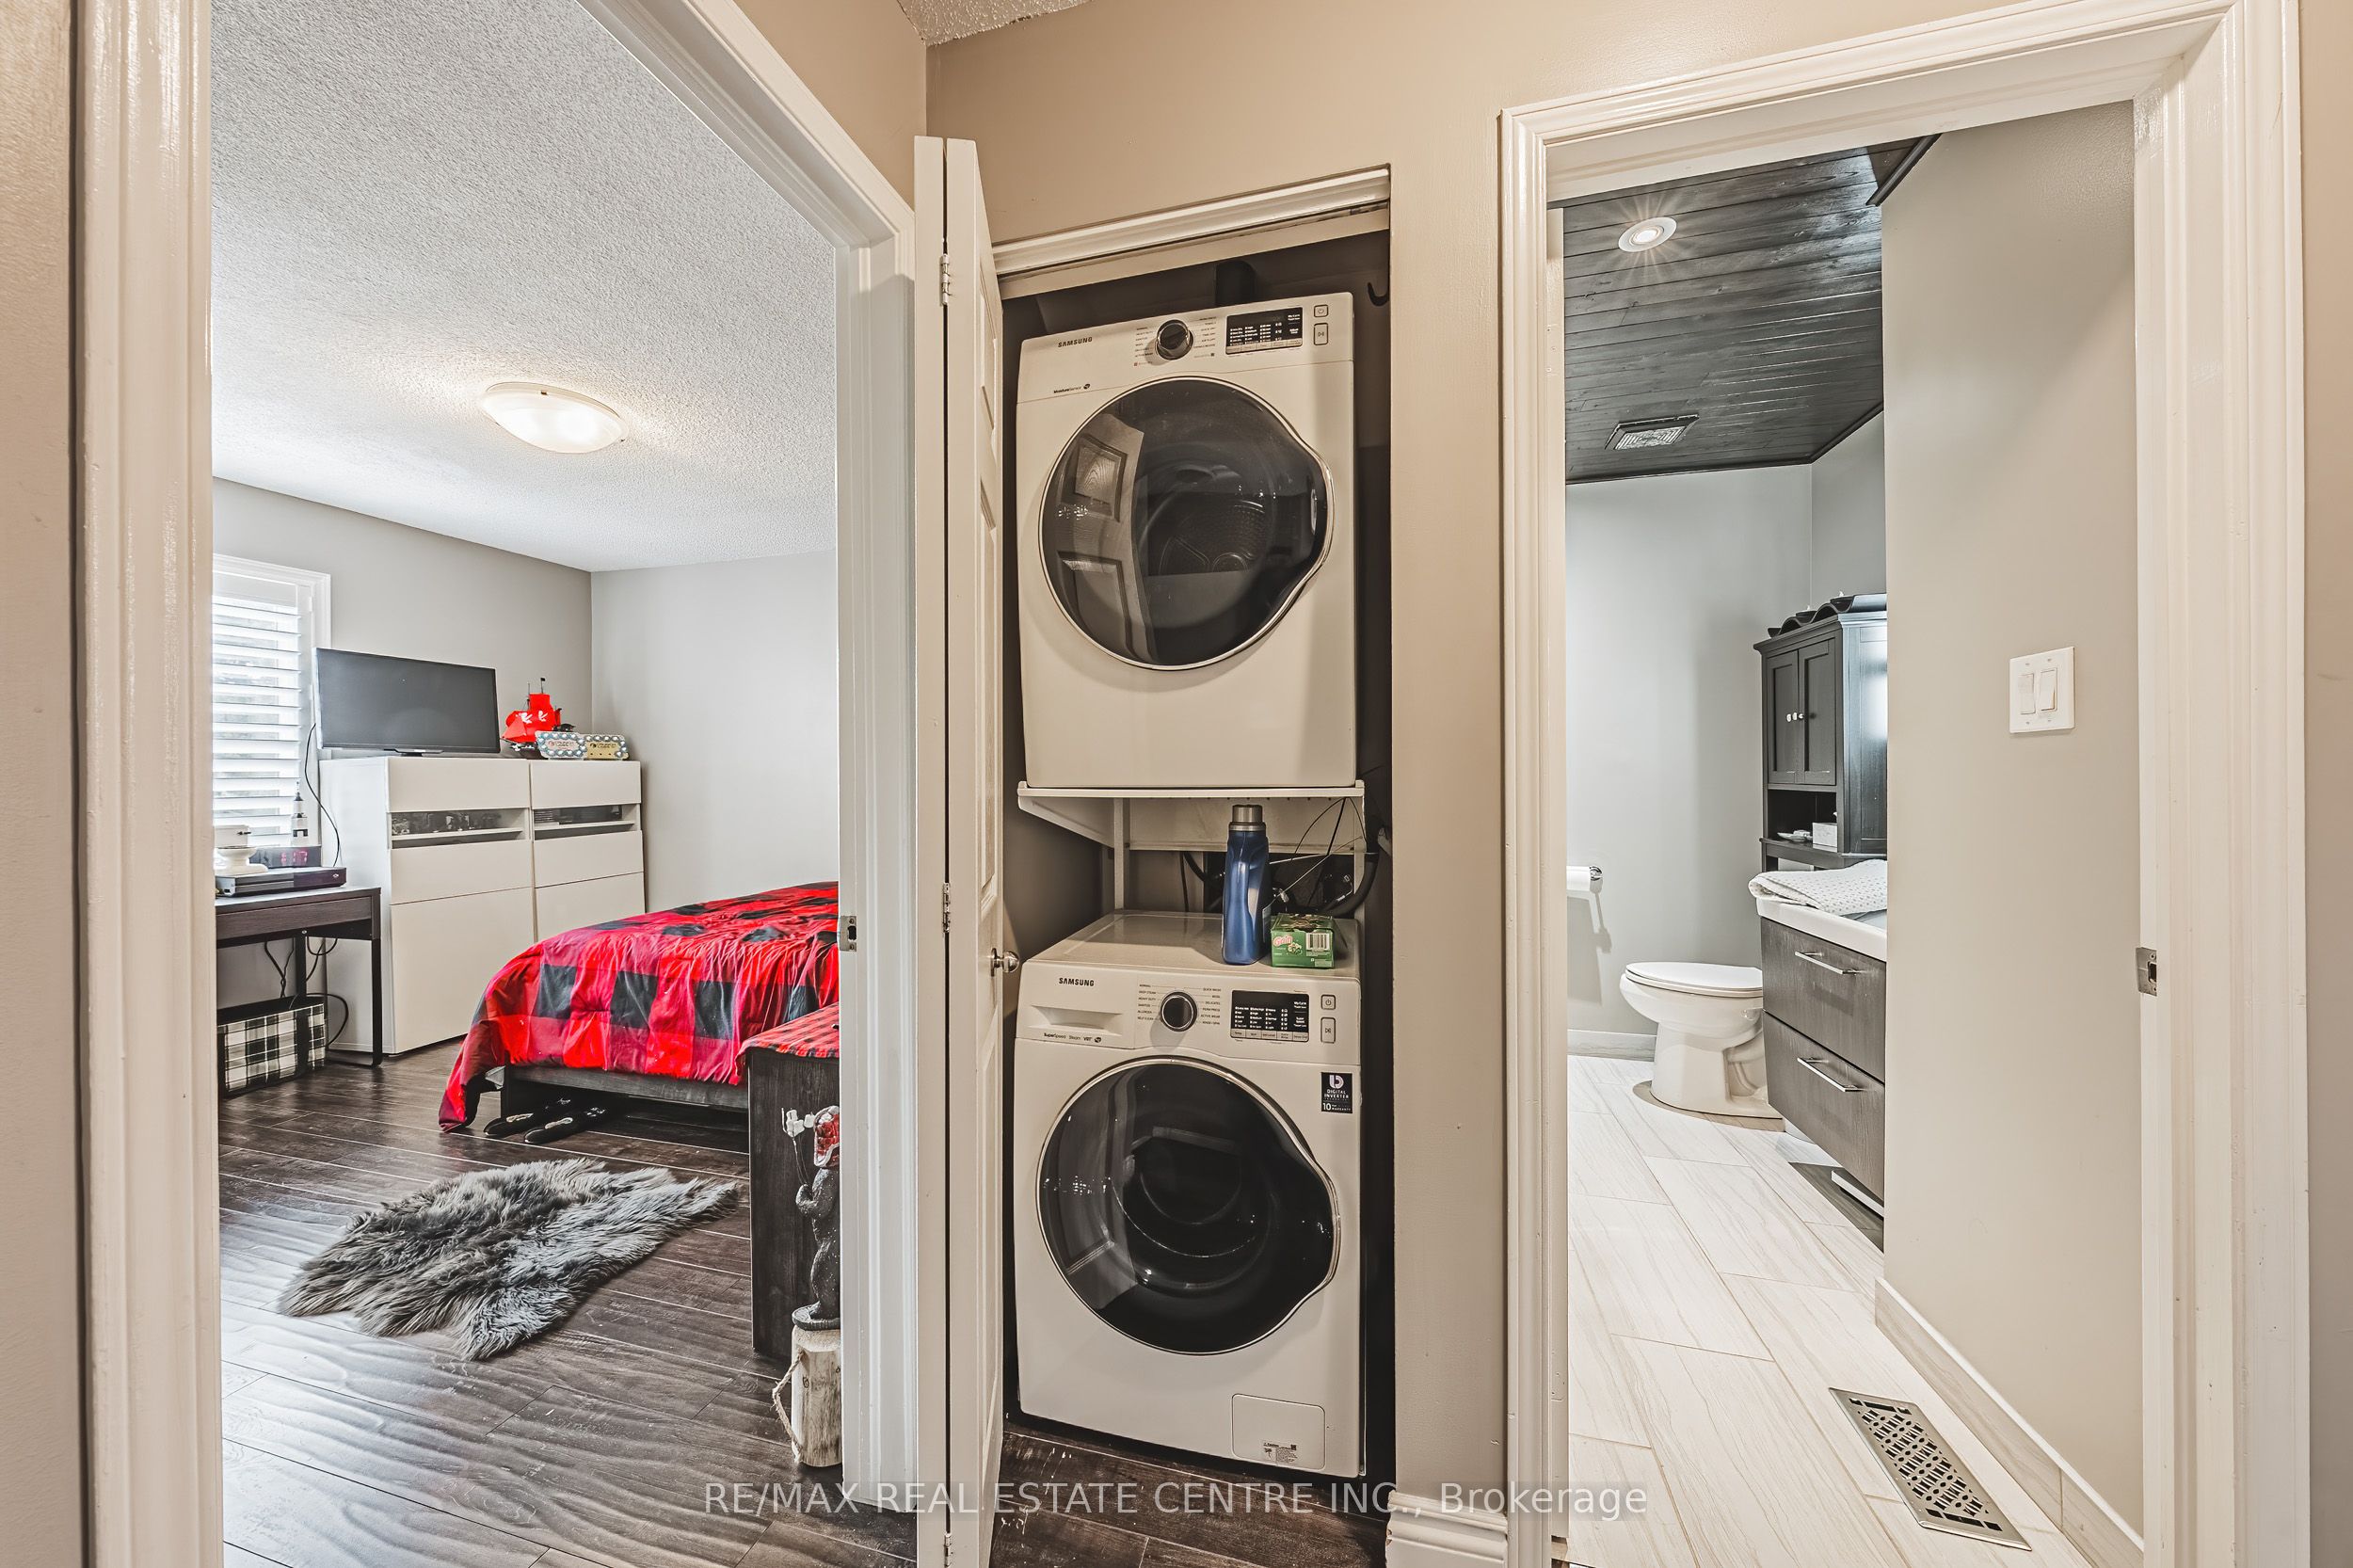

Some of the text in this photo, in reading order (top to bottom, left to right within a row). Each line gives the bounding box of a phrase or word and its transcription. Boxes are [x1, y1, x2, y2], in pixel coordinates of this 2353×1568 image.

[1057, 336, 1093, 347] SAMSUNG
[1273, 935, 1293, 947] Gain
[1058, 977, 1095, 987] SAMSUNG
[1322, 1102, 1332, 1111] 10
